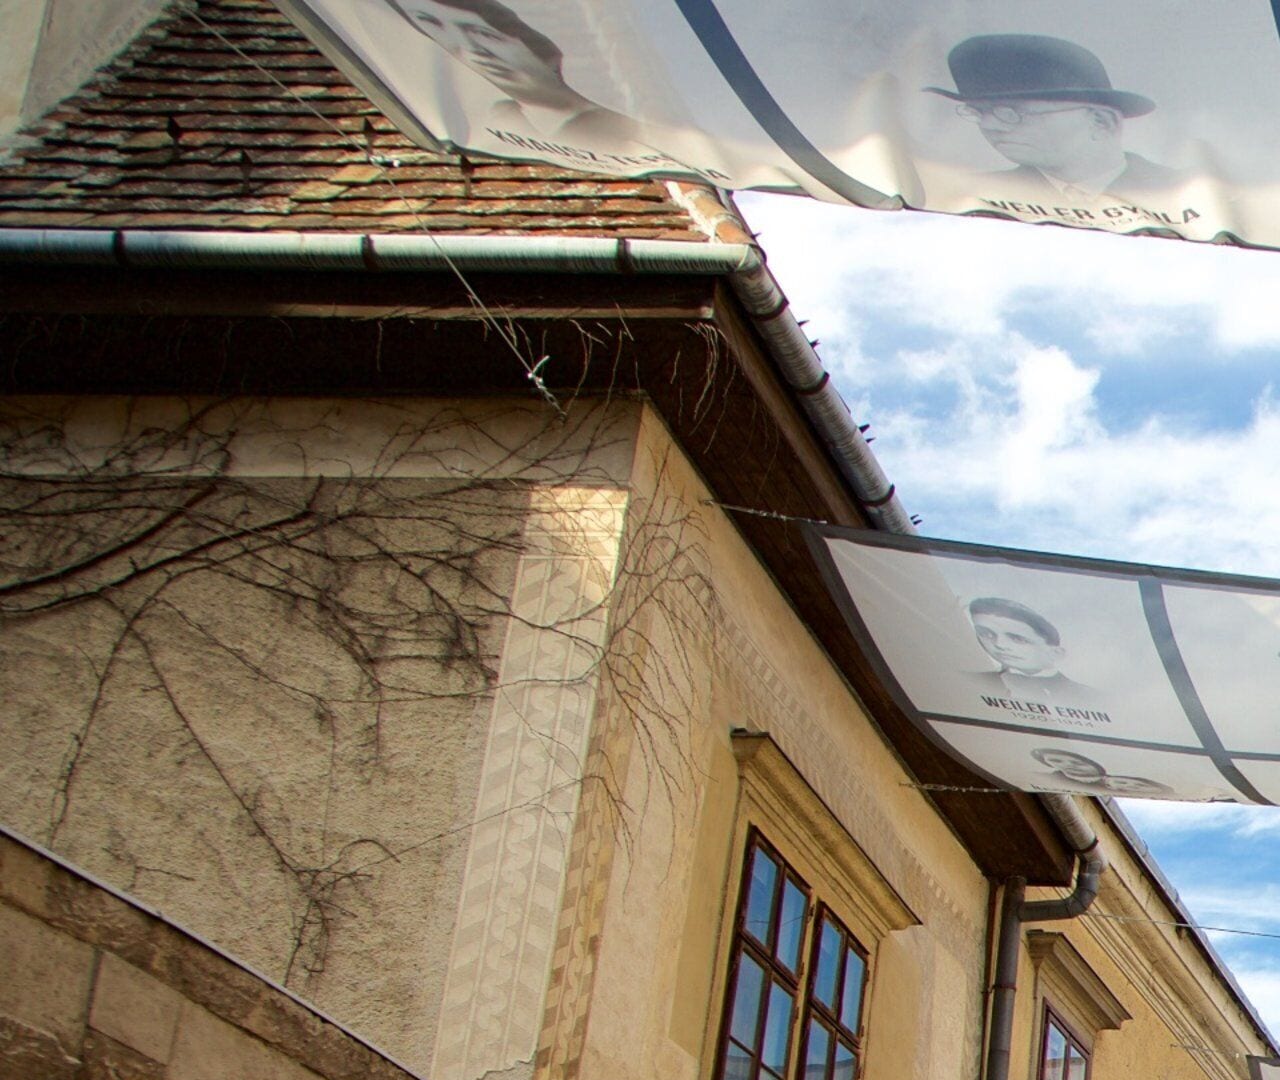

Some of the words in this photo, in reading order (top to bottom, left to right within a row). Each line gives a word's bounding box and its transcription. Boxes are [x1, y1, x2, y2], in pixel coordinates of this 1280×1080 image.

[485, 127, 608, 163] KRAUSZ
[980, 694, 1052, 716] WEILER
[1054, 705, 1112, 724] ERVIN
